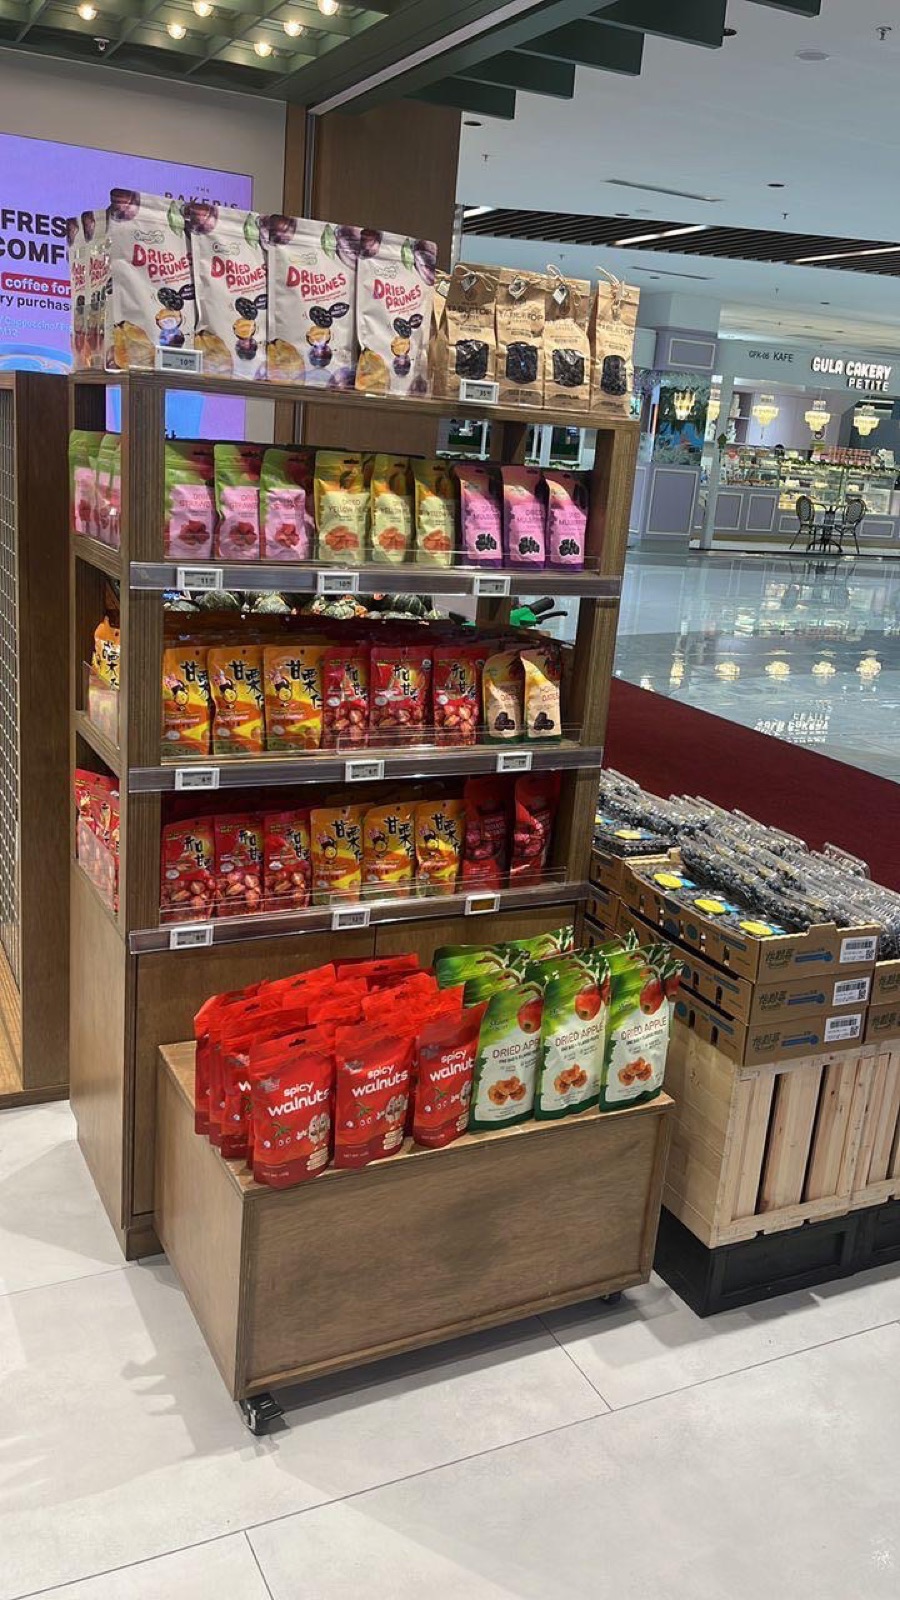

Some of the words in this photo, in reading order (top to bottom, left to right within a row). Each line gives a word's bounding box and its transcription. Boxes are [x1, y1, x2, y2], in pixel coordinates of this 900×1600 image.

[131, 243, 175, 267] DRIED
[148, 254, 193, 278] PRUNES
[210, 256, 249, 278] DRIED
[286, 266, 326, 287] DRIED
[5, 277, 49, 292] coffee
[300, 273, 346, 298] PRUNES
[373, 279, 406, 300] DRIED
[385, 285, 422, 310] PRUNES
[773, 351, 795, 363] KAFE
[811, 356, 844, 375] GULA
[845, 360, 892, 381] CAKERY
[847, 378, 890, 393] PETITE
[285, 659, 324, 711] 甘栗仁
[555, 1031, 580, 1048] DRIED
[580, 1022, 605, 1039] APPLE
[620, 1025, 643, 1041] DRIED
[644, 1017, 668, 1033] APPLE
[440, 1049, 467, 1064] spicy
[491, 1044, 522, 1059] DRIED
[351, 1069, 409, 1098] walnuts
[367, 1064, 395, 1080] spicy
[283, 1081, 314, 1098] spicy
[268, 1088, 330, 1117] walnuts
